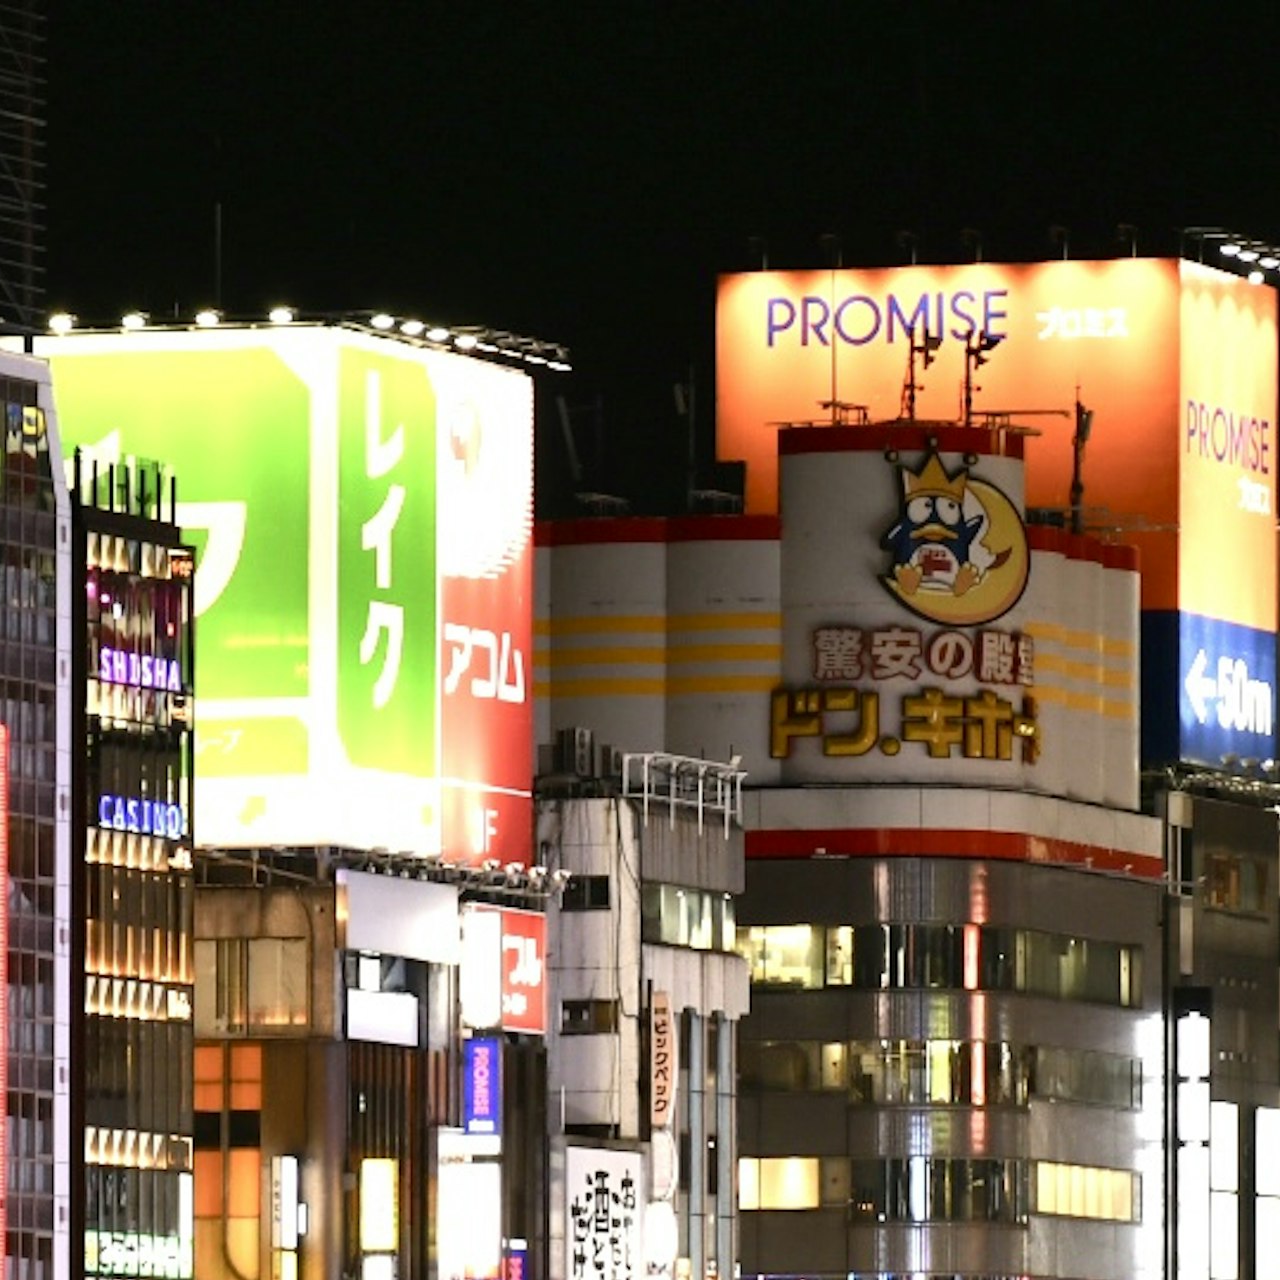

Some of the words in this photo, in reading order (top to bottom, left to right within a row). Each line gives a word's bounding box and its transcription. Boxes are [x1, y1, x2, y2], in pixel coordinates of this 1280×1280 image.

[766, 289, 1009, 347] PROMISE
[1036, 306, 1129, 340] プロミス
[1186, 400, 1271, 477] PROMISE
[359, 368, 406, 710] レイク
[100, 646, 181, 691] SHISHA
[444, 622, 526, 703] アコム
[1216, 656, 1272, 736] 50m
[99, 795, 182, 841] CASINO
